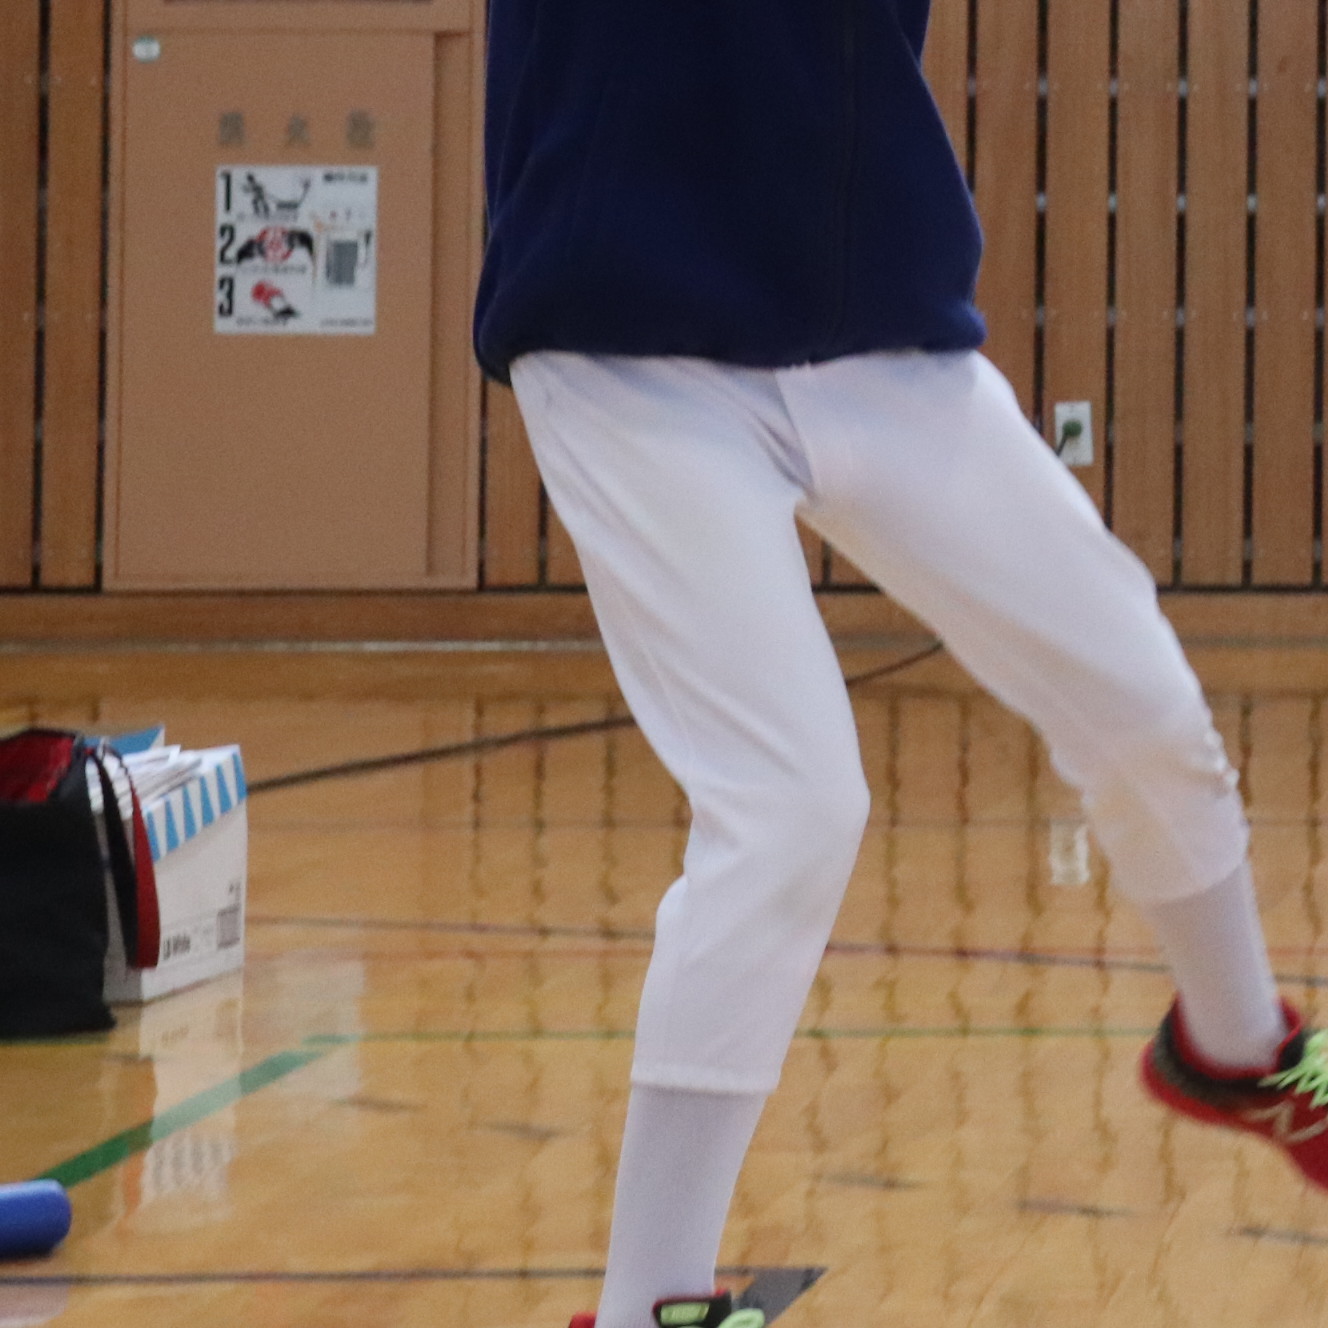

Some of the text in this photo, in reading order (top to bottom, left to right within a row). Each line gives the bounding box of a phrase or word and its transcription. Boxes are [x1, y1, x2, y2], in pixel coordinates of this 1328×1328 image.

[220, 171, 231, 211] 1
[219, 225, 235, 264] 2
[218, 277, 234, 316] 3
